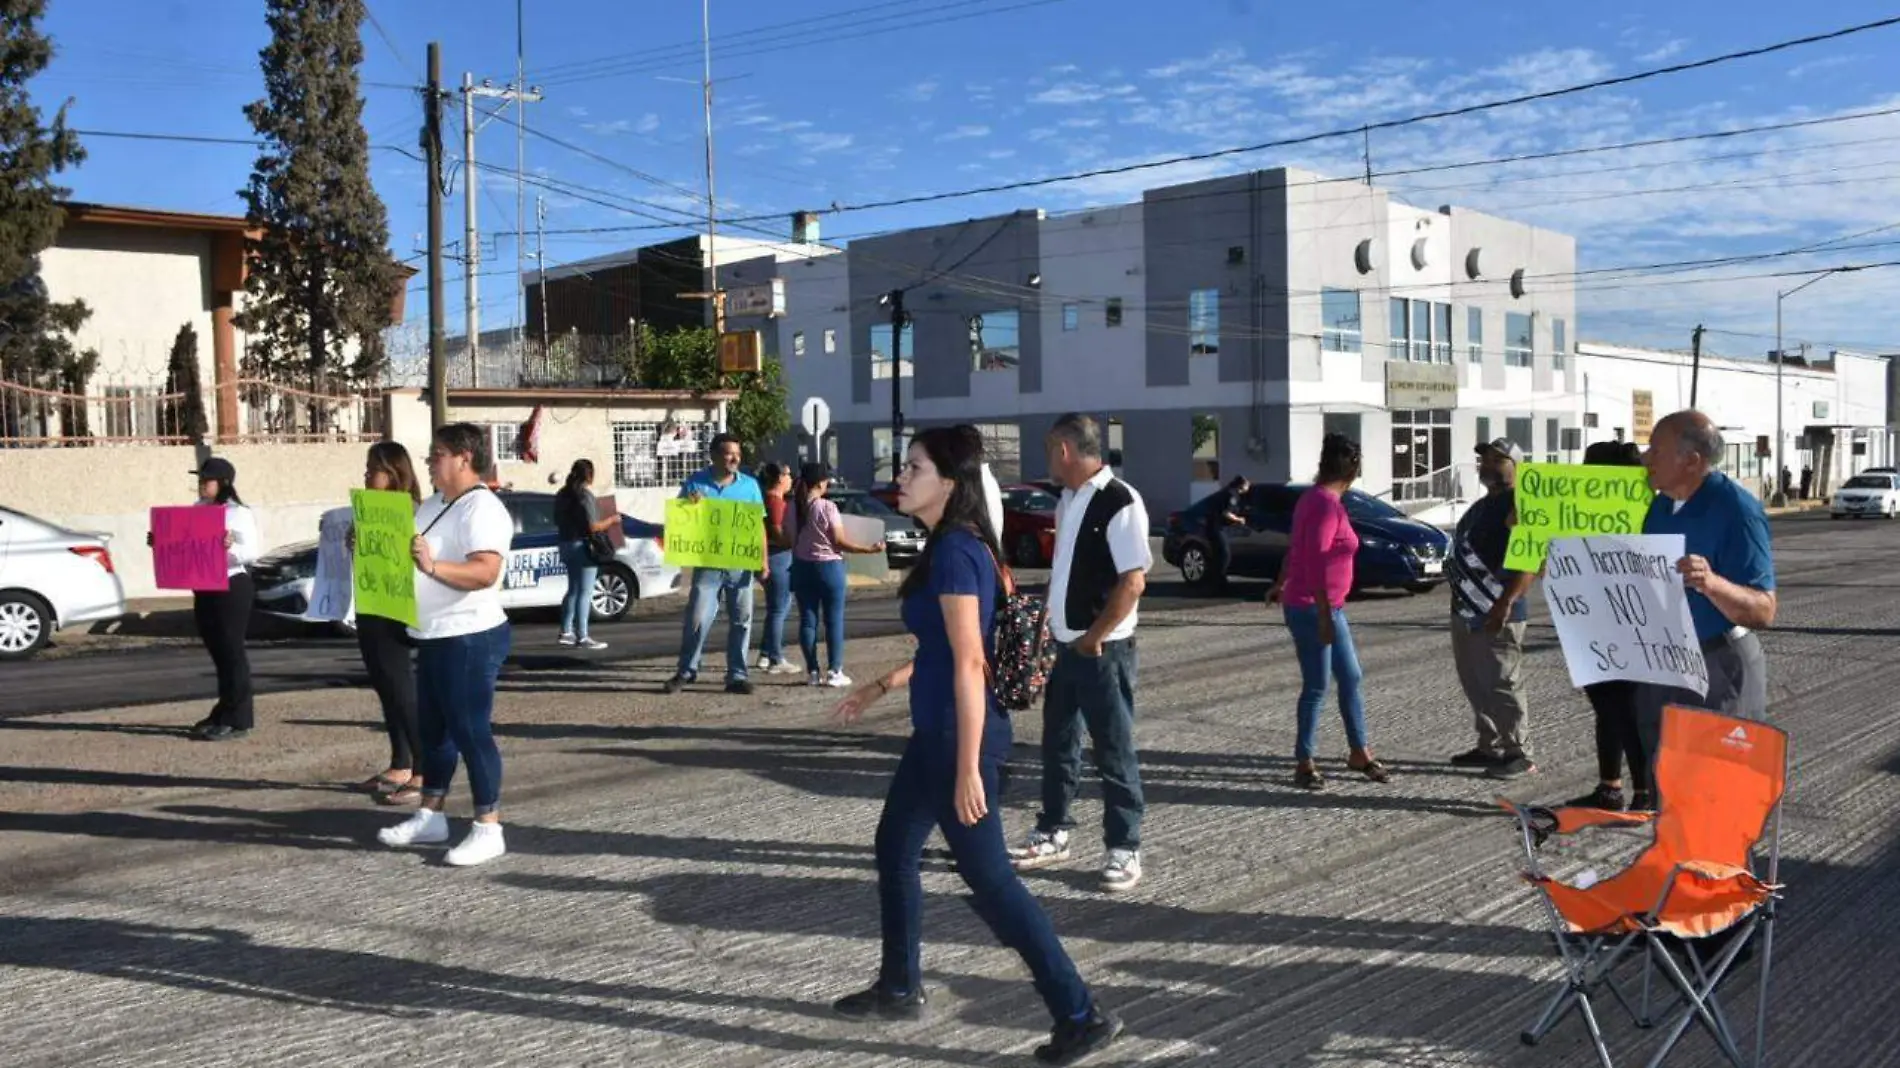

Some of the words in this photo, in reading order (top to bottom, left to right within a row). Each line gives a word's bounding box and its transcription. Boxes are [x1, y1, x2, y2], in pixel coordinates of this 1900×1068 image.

[710, 508, 721, 526] a
[732, 502, 756, 531] los
[1519, 498, 1549, 527] los
[1558, 501, 1632, 534] libros
[709, 535, 724, 555] de
[1510, 531, 1549, 557] otr
[514, 554, 533, 569] DEL
[1547, 540, 1582, 579] Sin
[359, 564, 377, 593] de
[508, 570, 537, 588] VIAL
[1549, 583, 1591, 616] tas
[1604, 583, 1647, 627] NO
[1589, 640, 1629, 671] se
